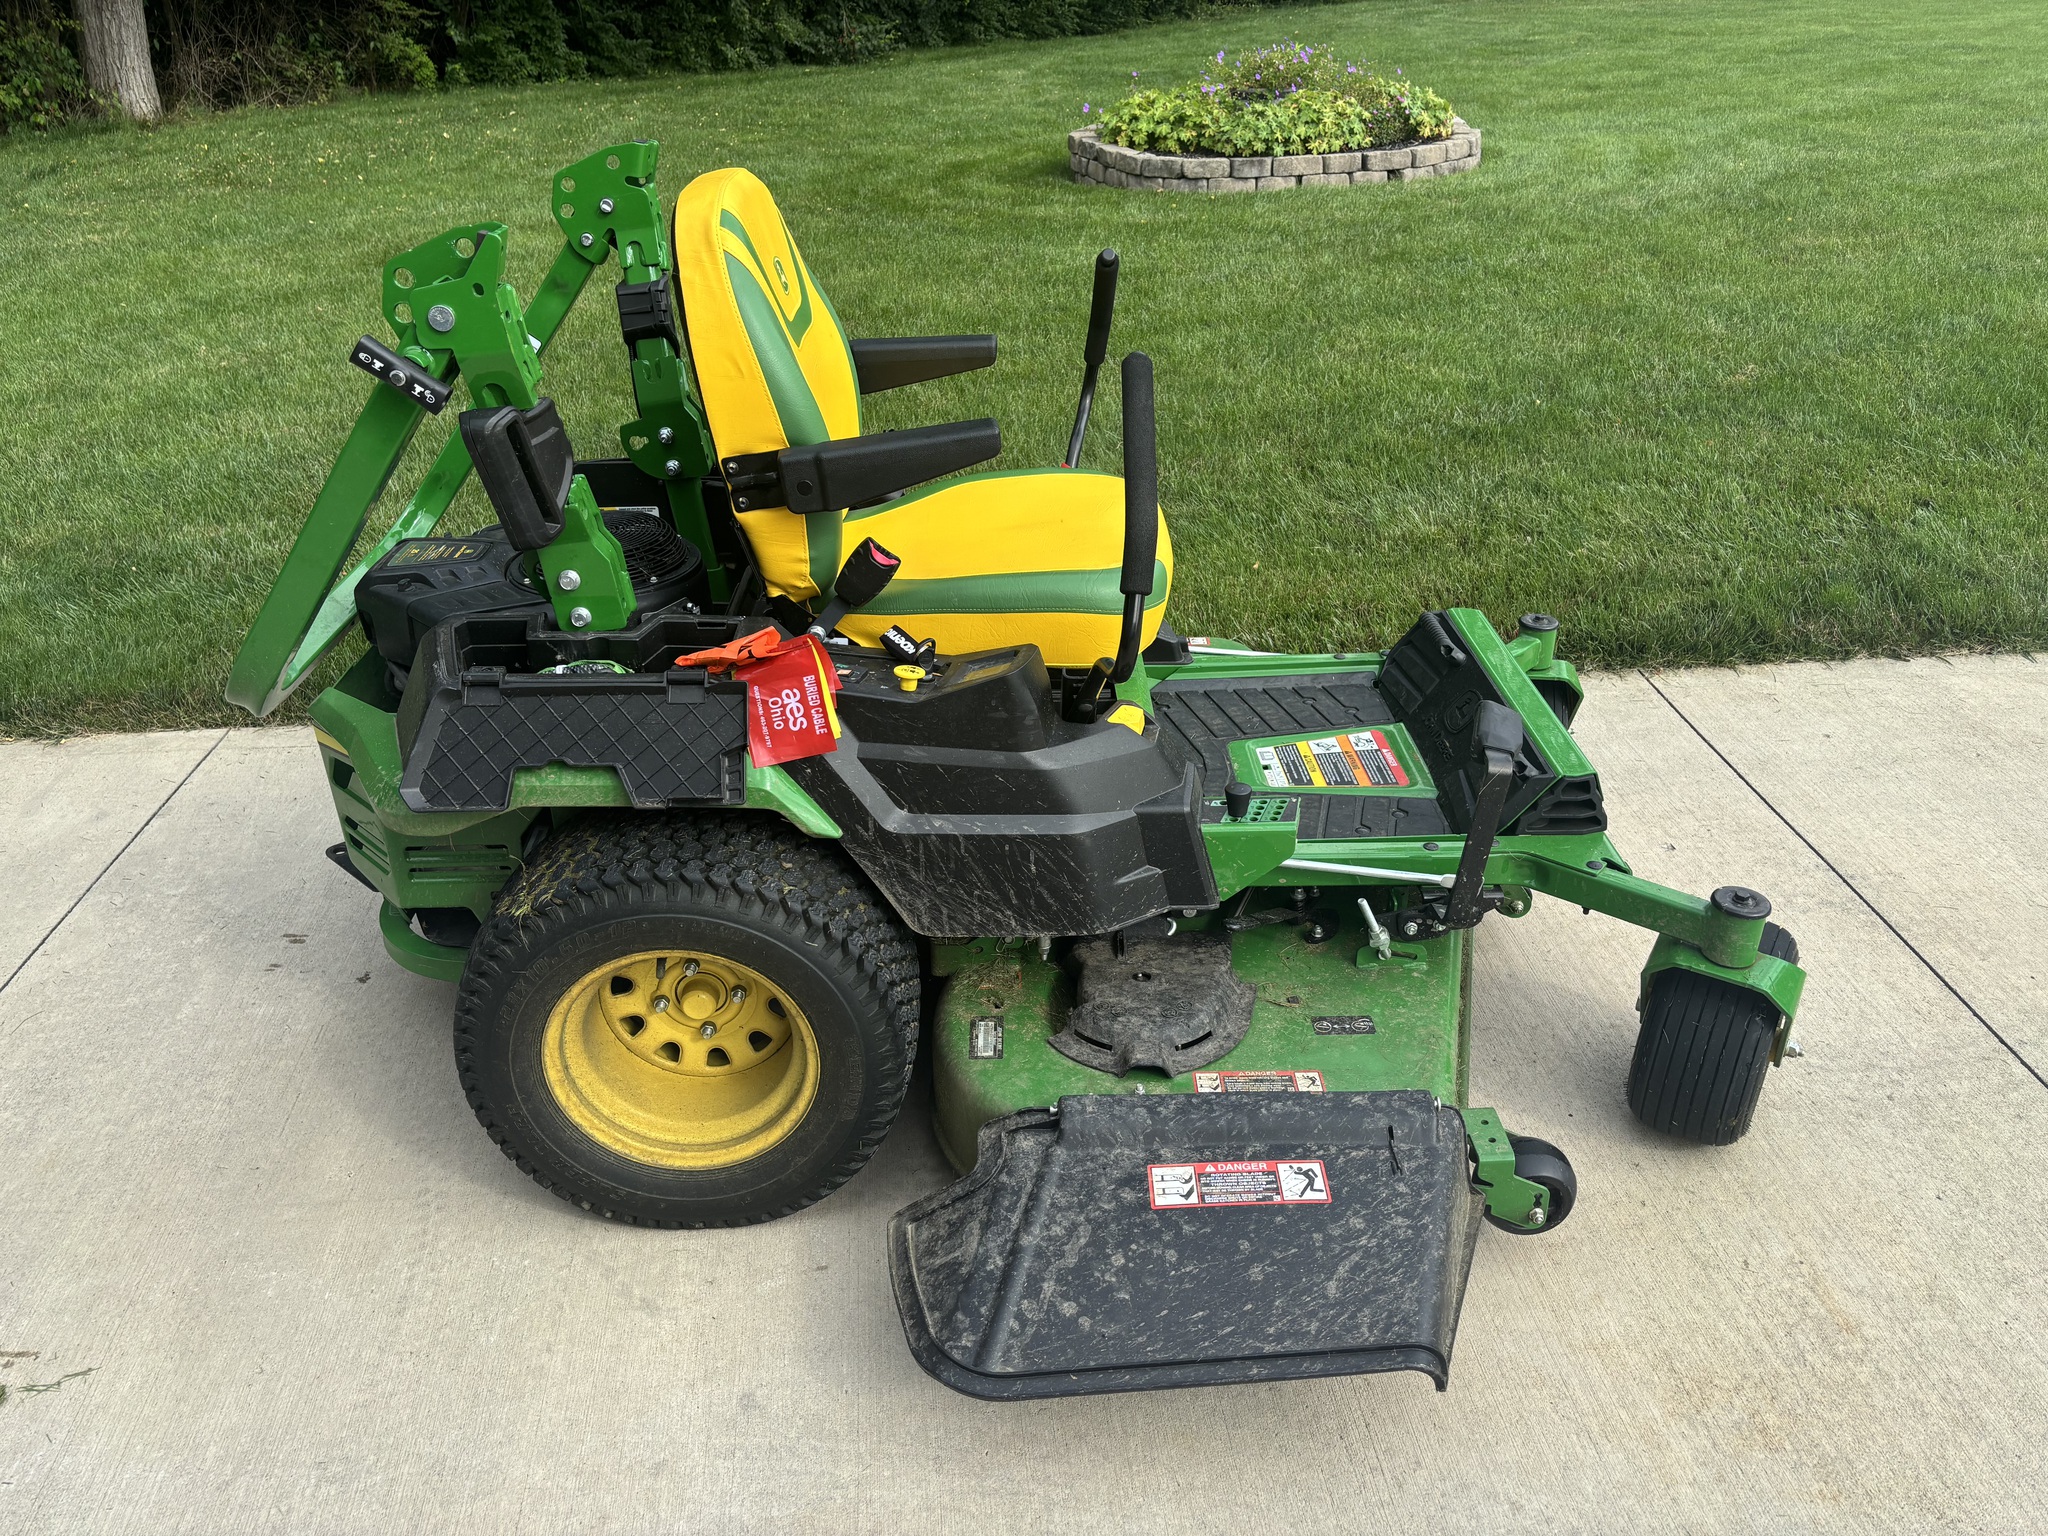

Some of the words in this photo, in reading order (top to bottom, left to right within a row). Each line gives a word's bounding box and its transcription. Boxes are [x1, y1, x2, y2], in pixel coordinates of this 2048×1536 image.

[803, 675, 820, 706] BURIED
[768, 697, 785, 730] Ohio
[781, 688, 808, 731] aes
[811, 708, 828, 735] CABLE
[1217, 1162, 1268, 1171] DANGER
